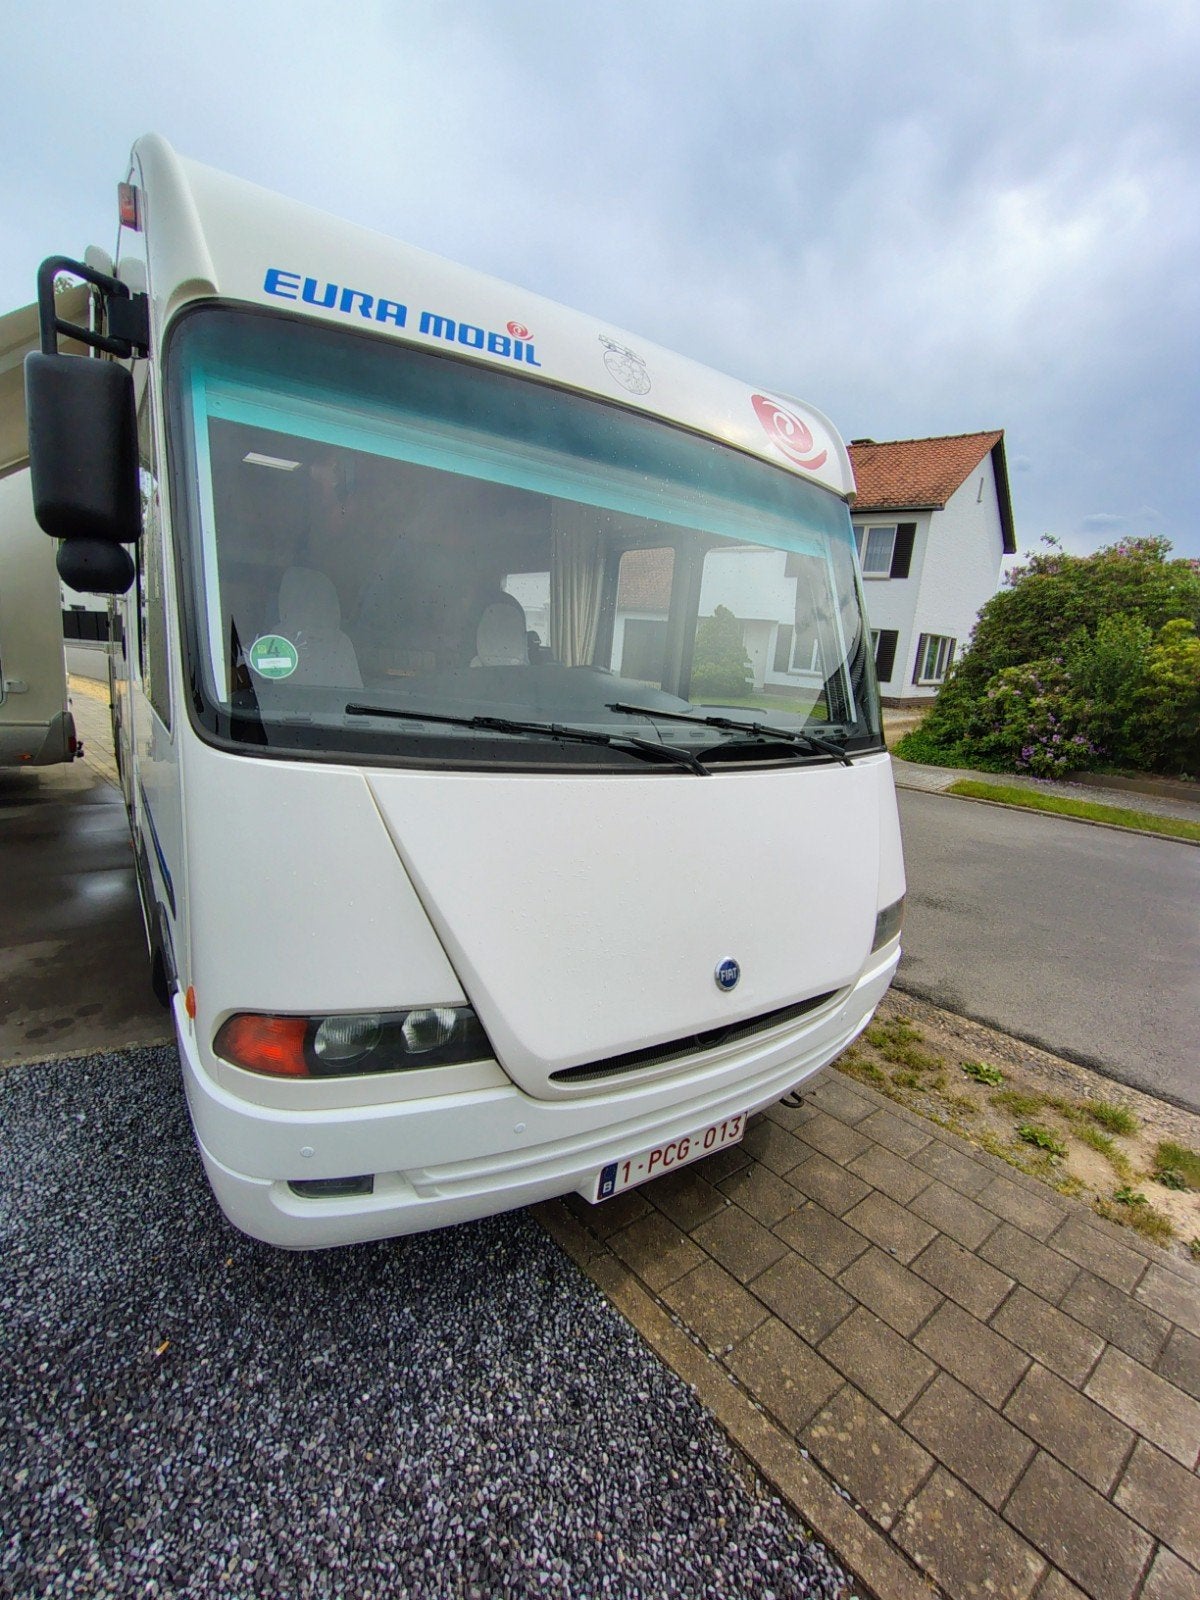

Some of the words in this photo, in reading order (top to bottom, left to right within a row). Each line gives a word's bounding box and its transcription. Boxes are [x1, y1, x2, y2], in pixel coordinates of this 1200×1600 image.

[263, 268, 407, 328] EURA
[419, 311, 542, 367] MOBIL
[721, 967, 737, 982] FIAT
[622, 1116, 742, 1184] 1-PCG-013
[603, 1181, 613, 1194] B
